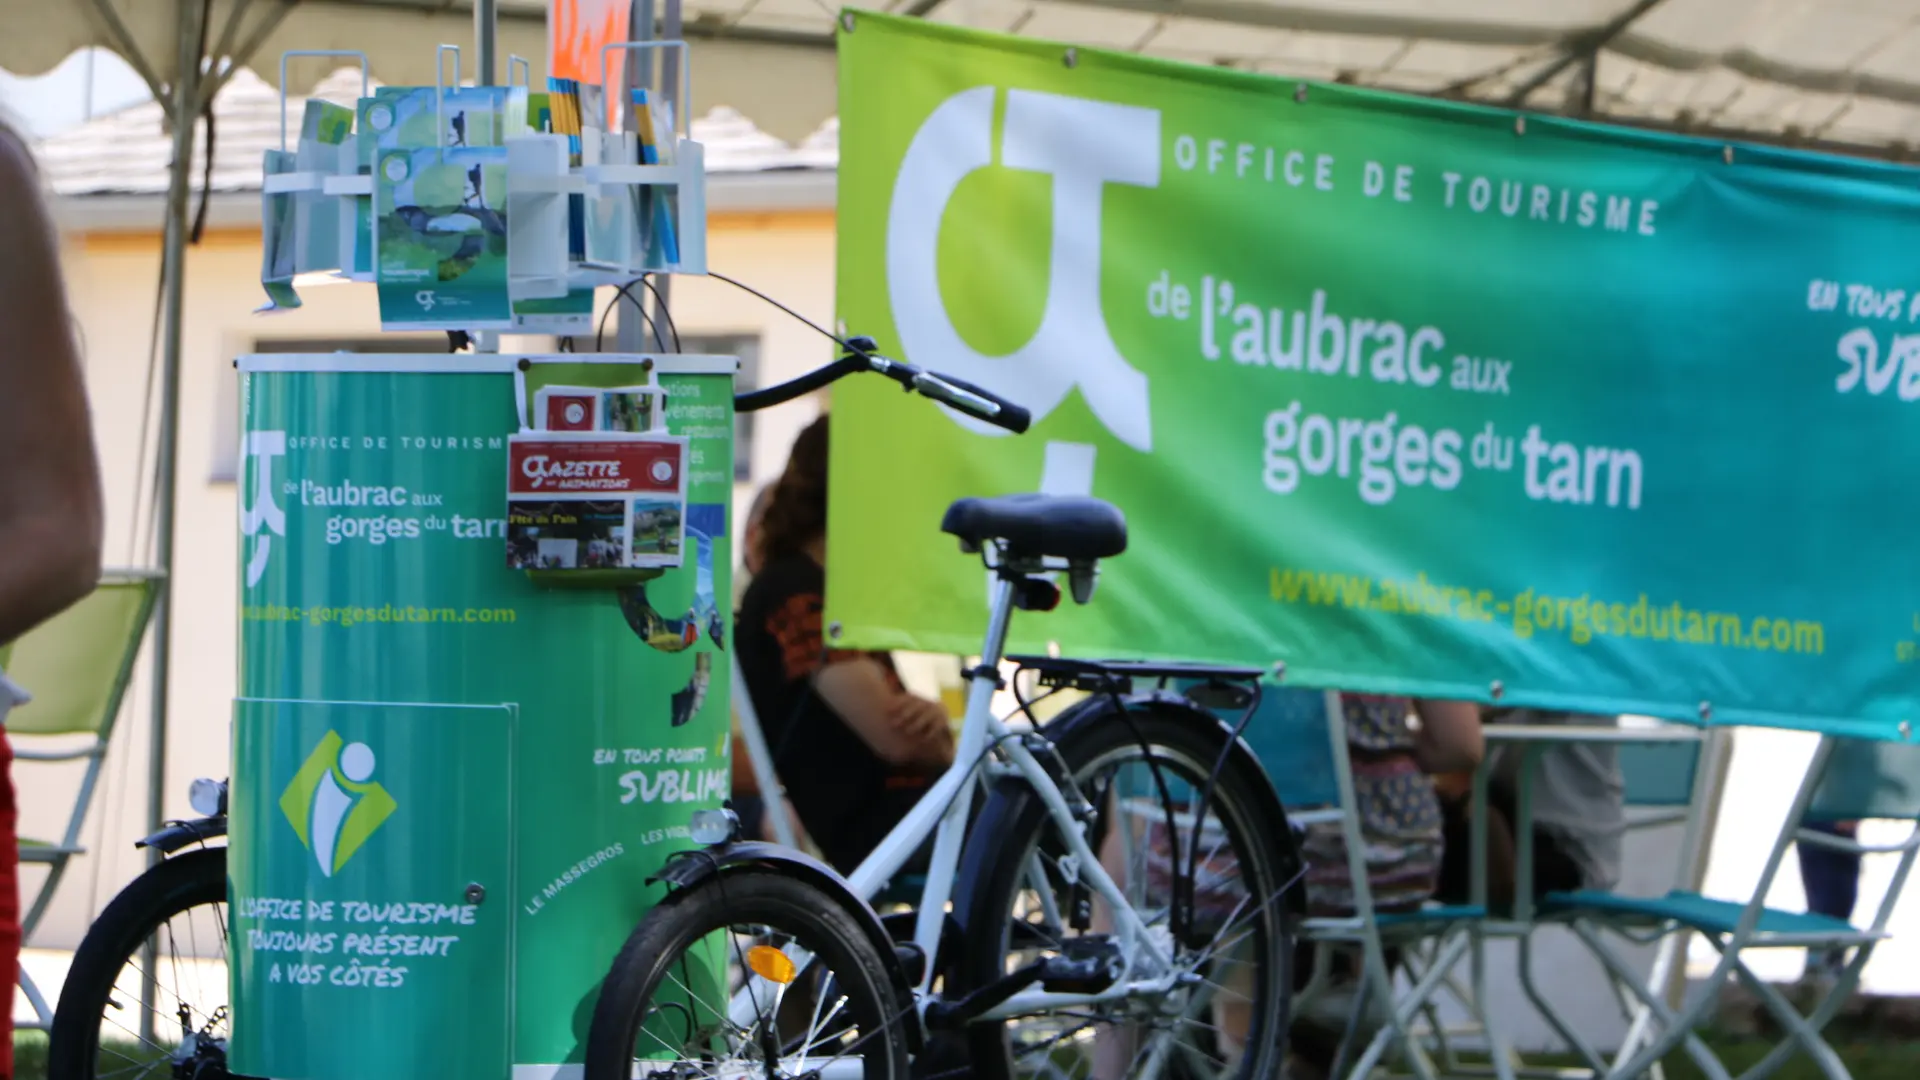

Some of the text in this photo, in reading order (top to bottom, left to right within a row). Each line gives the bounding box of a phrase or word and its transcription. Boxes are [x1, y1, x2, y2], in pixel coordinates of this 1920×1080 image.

[1174, 134, 1659, 236] OFFICE DE TOURISME
[1807, 277, 1841, 312] EN
[1845, 284, 1906, 322] TOUS
[1146, 270, 1512, 395] de l'aubrac aux
[289, 436, 351, 449] OFFICE
[363, 436, 388, 449] DE
[1262, 400, 1643, 509] gorges du tarn
[283, 478, 443, 507] de l'aubrac aux
[326, 514, 420, 544] gorges
[424, 514, 447, 531] du
[1269, 566, 1825, 656] www.aubrac-gorgesdutarn.com
[593, 746, 708, 765] EN TOUS POINTS
[641, 828, 664, 846] LES
[524, 842, 625, 917] LE MASSEGROS
[308, 899, 335, 922] DE
[341, 900, 478, 926] TOURISME
[246, 925, 460, 957] TOUJOURS PRÉSENT
[269, 958, 409, 987] A VOS CÔTÉS
